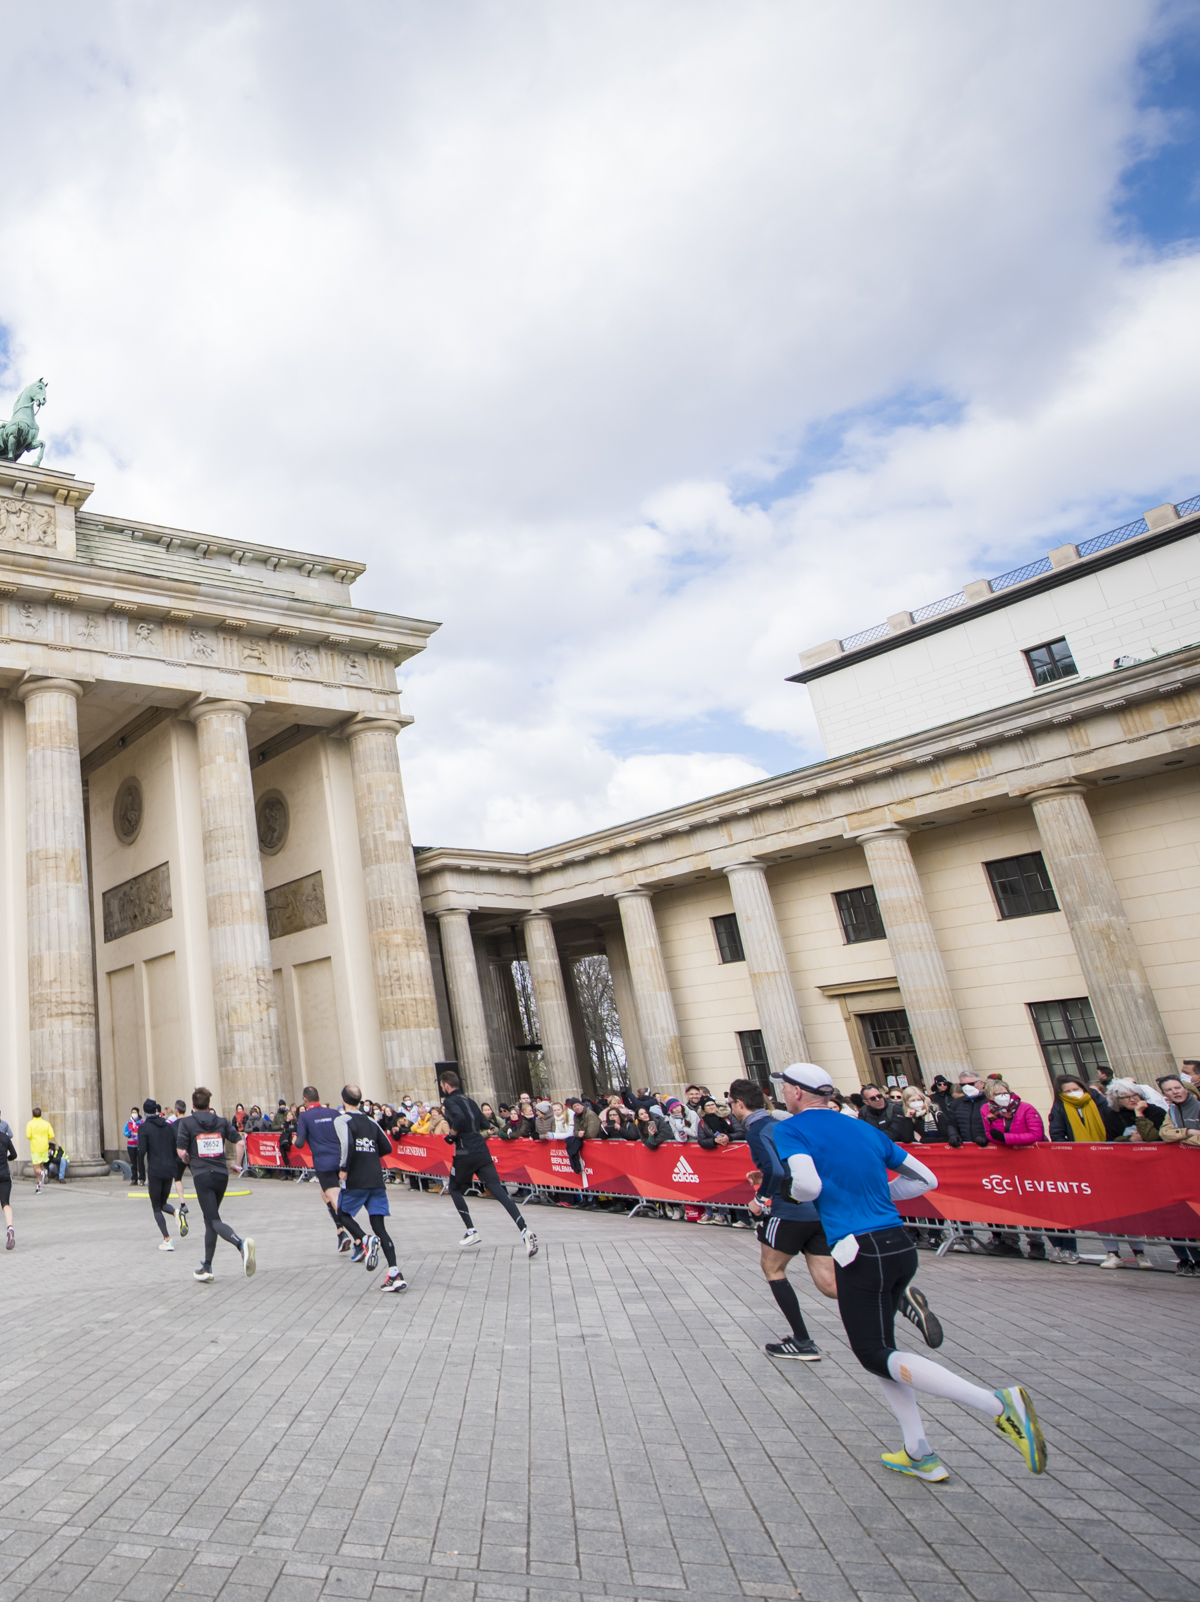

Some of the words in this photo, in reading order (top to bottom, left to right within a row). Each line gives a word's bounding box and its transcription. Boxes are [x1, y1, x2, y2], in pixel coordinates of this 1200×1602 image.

[356, 1137, 375, 1147] SCC
[403, 1146, 427, 1157] GENERALI
[551, 1157, 571, 1166] BERLINE
[672, 1172, 699, 1183] adidas
[982, 1175, 1013, 1194] SCC
[1024, 1180, 1091, 1194] EVENTS
